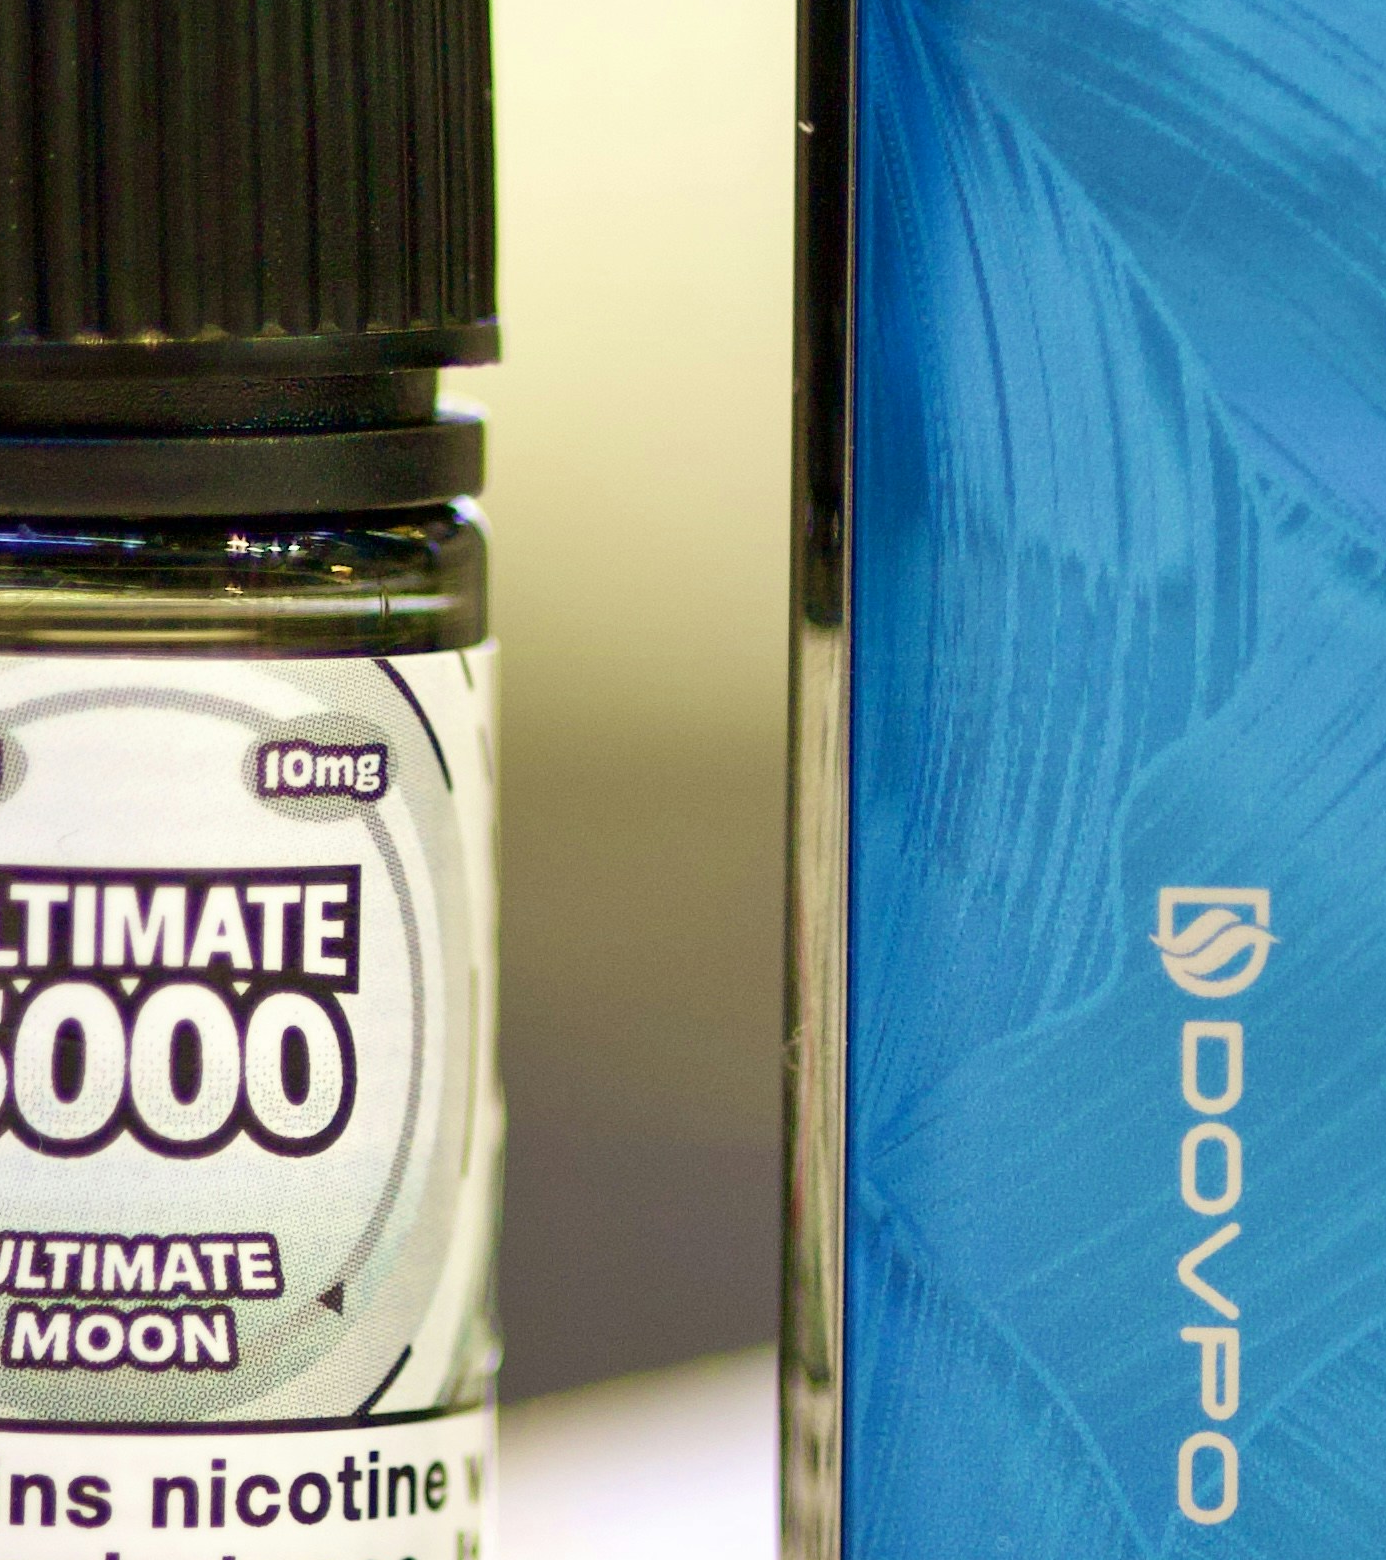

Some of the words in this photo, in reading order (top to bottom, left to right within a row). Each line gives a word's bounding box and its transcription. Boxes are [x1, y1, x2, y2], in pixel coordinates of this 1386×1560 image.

[263, 747, 382, 794] 10mg
[1177, 1020, 1244, 1526] DOVPO
[10, 1311, 231, 1365] MOON
[151, 1450, 447, 1530] nicotine
